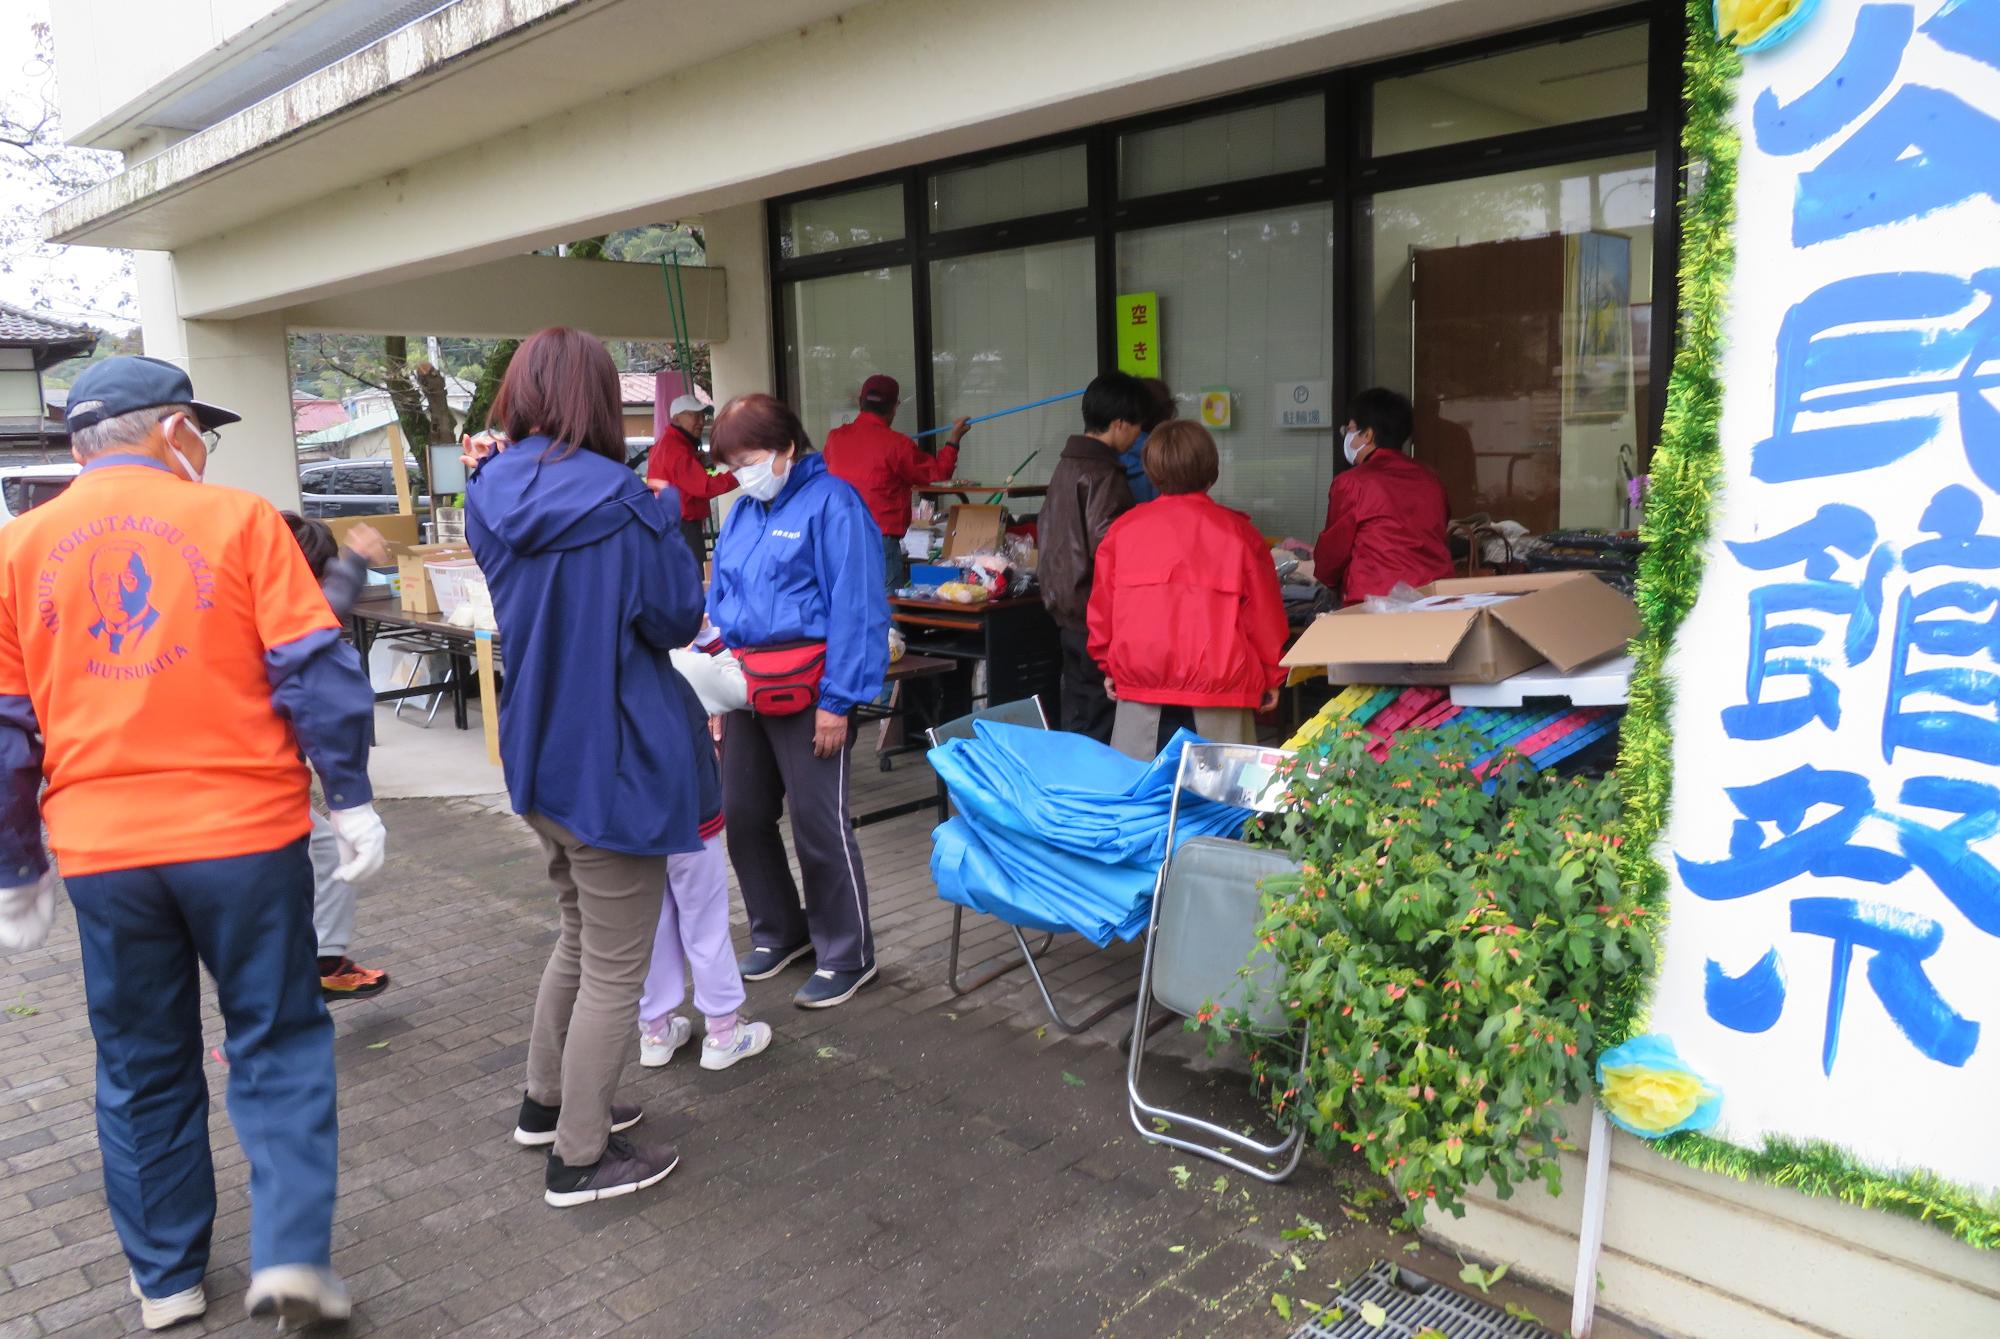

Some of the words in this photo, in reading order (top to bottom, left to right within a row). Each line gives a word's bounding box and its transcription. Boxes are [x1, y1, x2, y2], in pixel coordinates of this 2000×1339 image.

[1131, 303, 1148, 361] 空き
[48, 515, 185, 564] TOKUTAROU
[183, 545, 215, 610] OKINA
